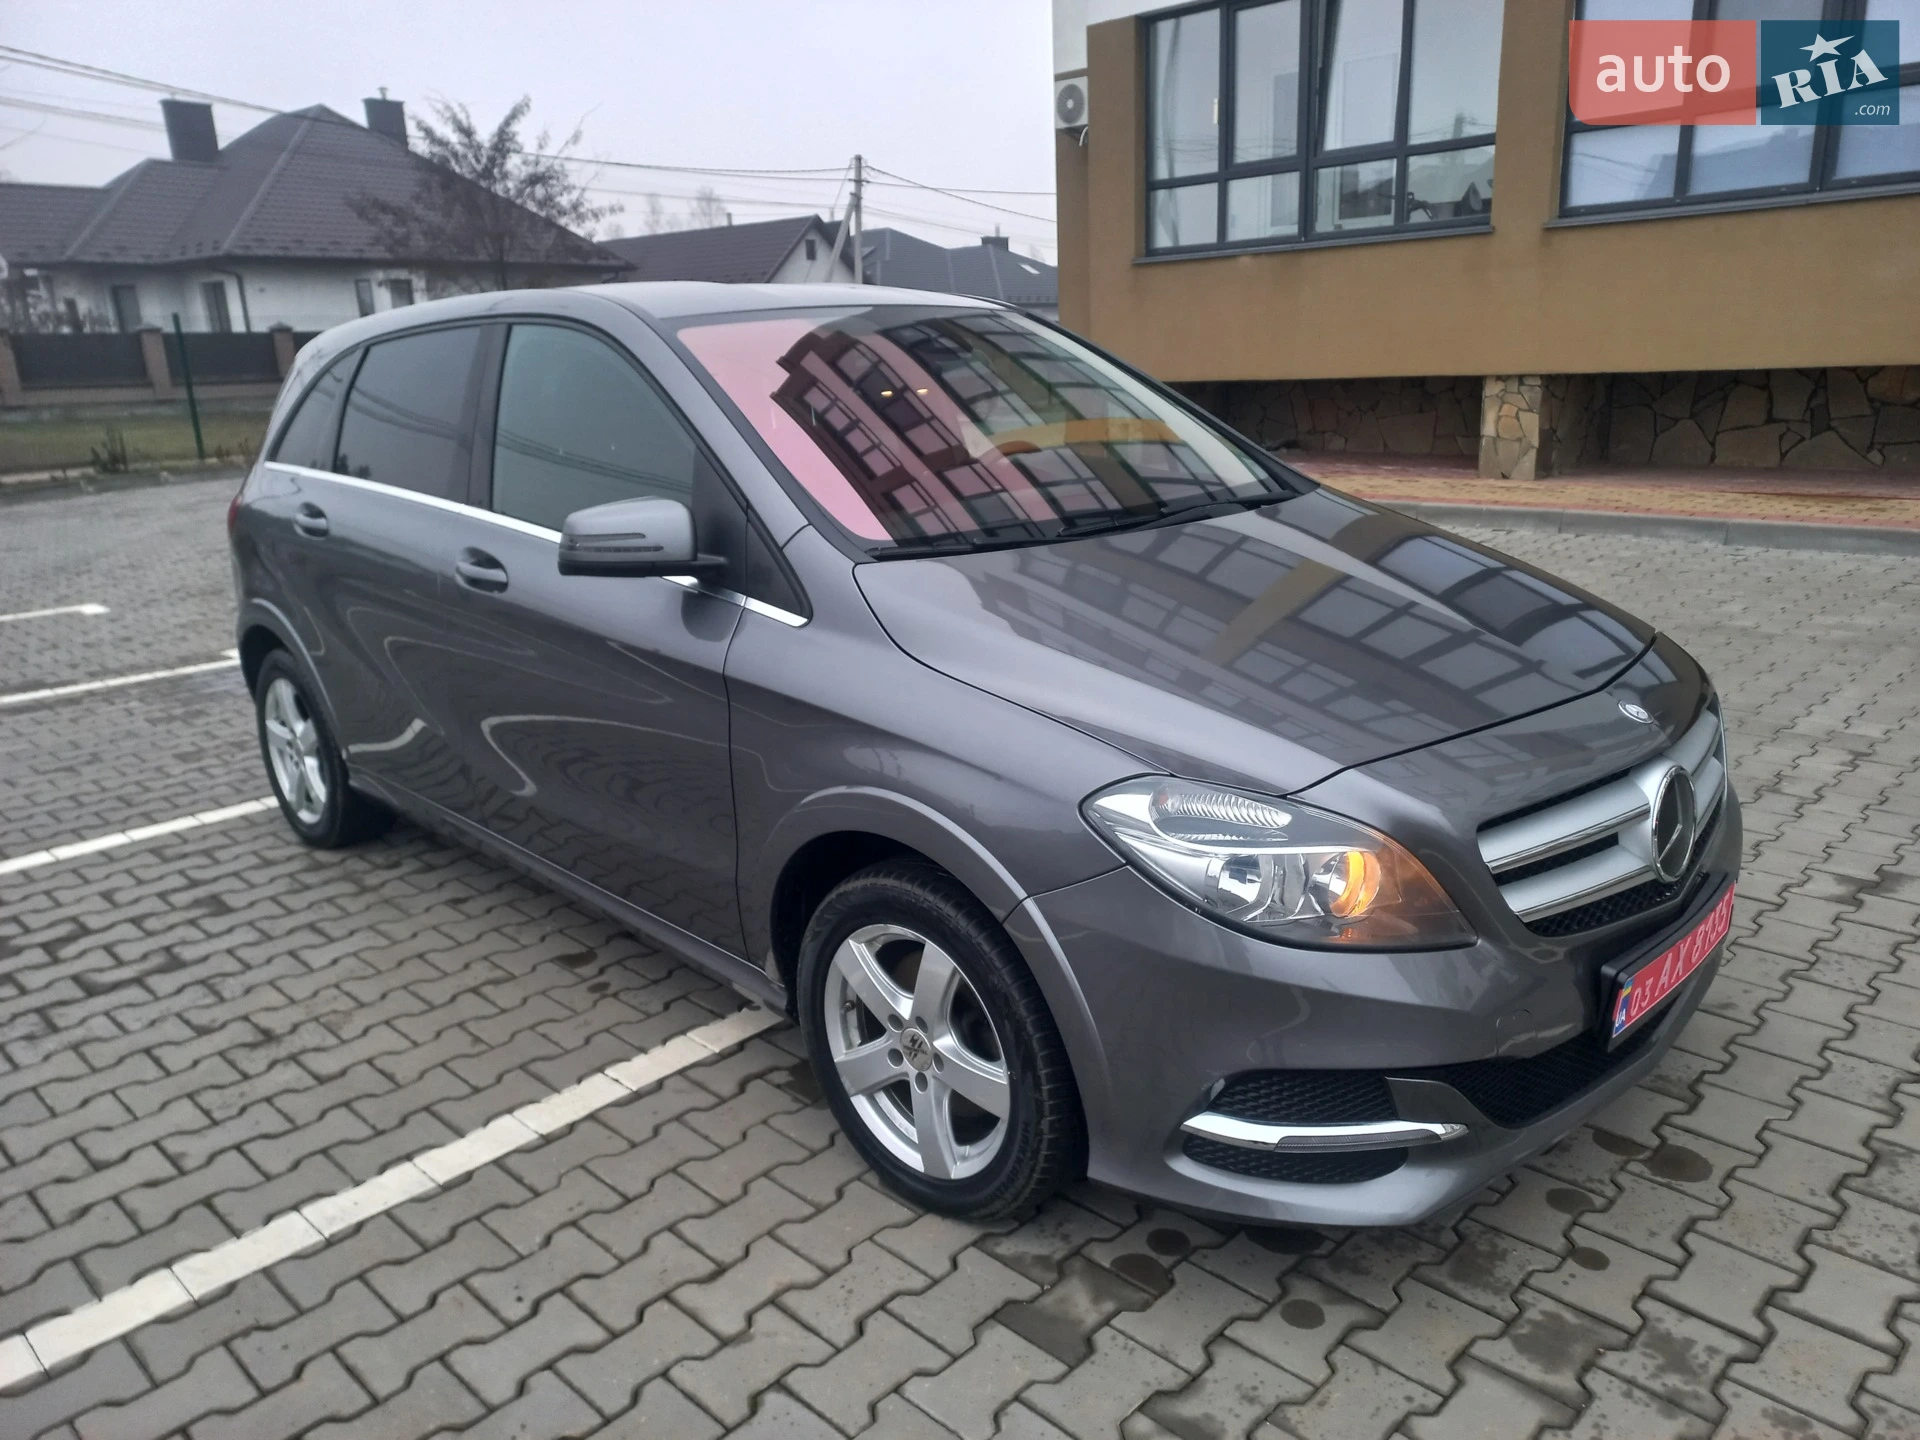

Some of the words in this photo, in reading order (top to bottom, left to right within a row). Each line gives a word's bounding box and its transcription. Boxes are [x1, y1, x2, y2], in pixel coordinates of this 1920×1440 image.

[1630, 977, 1654, 1017] 03
[1655, 937, 1692, 997] AX
[1615, 1008, 1626, 1027] UA
